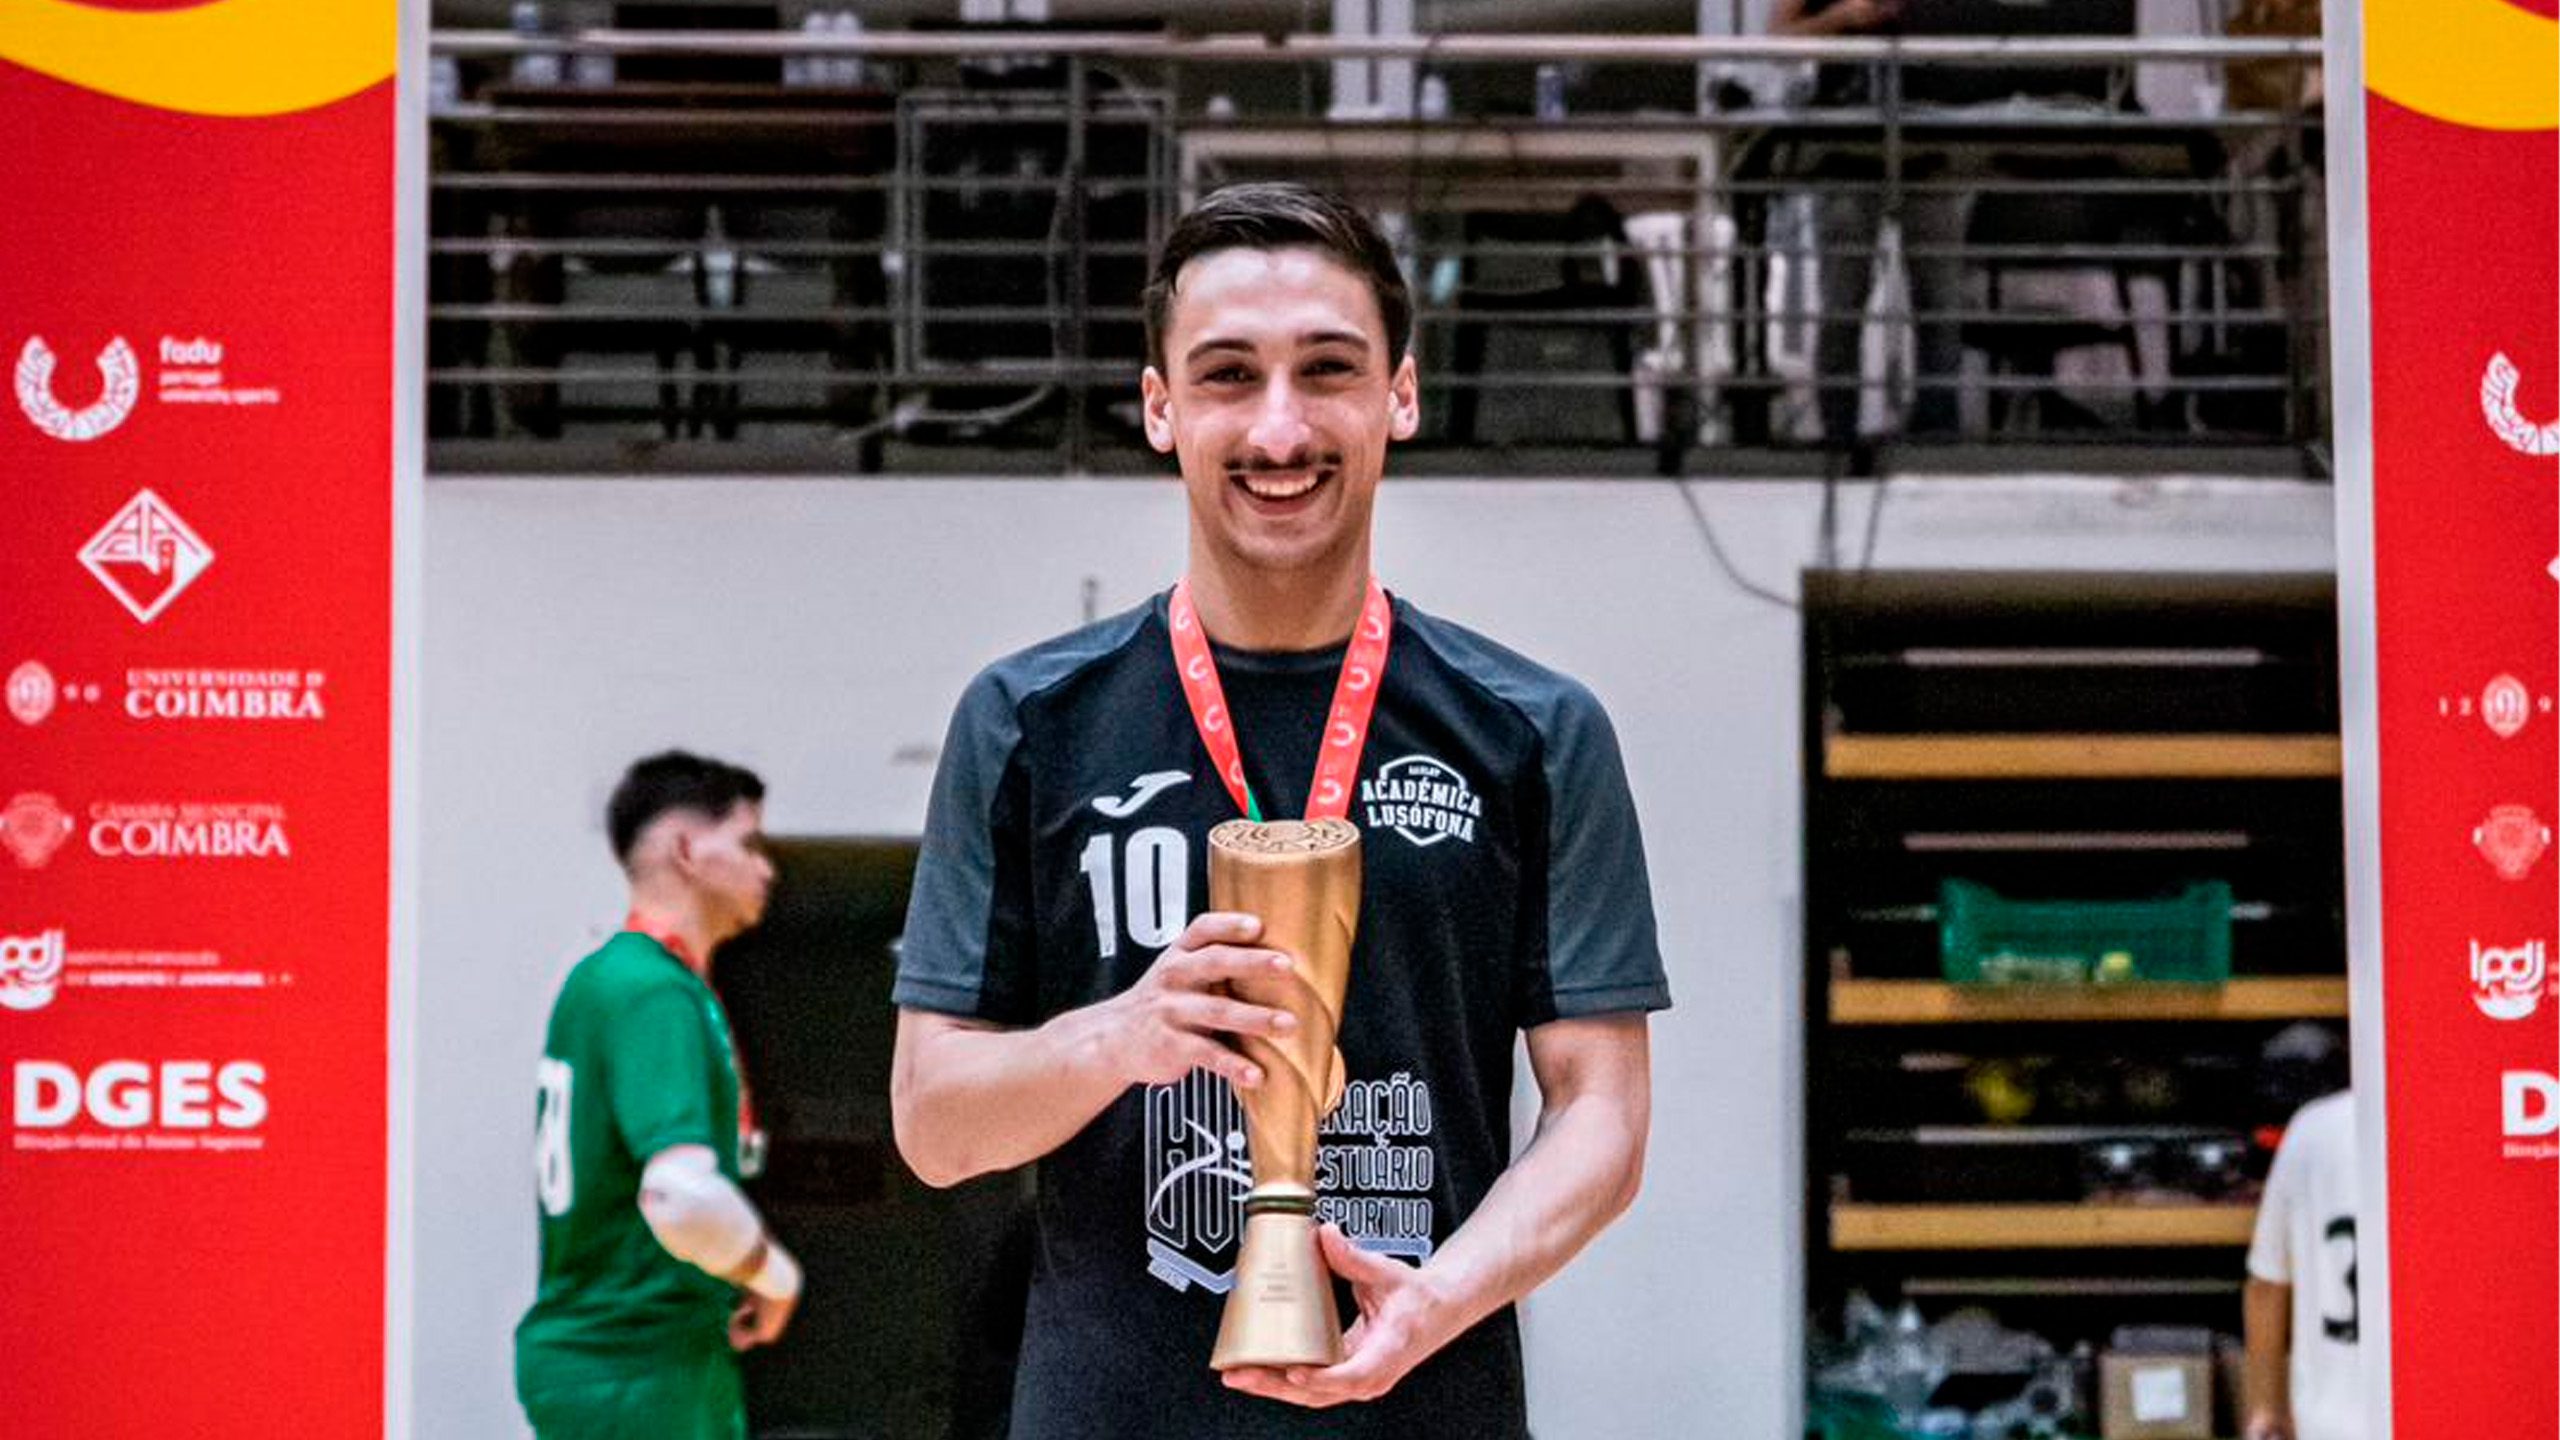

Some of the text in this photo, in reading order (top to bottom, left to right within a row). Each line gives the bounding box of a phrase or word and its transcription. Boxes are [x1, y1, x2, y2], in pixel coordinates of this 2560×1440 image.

[126, 669, 299, 687] UNIVERSIDADE
[125, 688, 325, 719] COIMBRA
[1362, 777, 1482, 816] ACADÉMICA
[88, 820, 291, 857] COIMBRA
[1367, 802, 1475, 842] LUSÓFONA
[1079, 826, 1189, 958] 10
[13, 1060, 269, 1129] DGES
